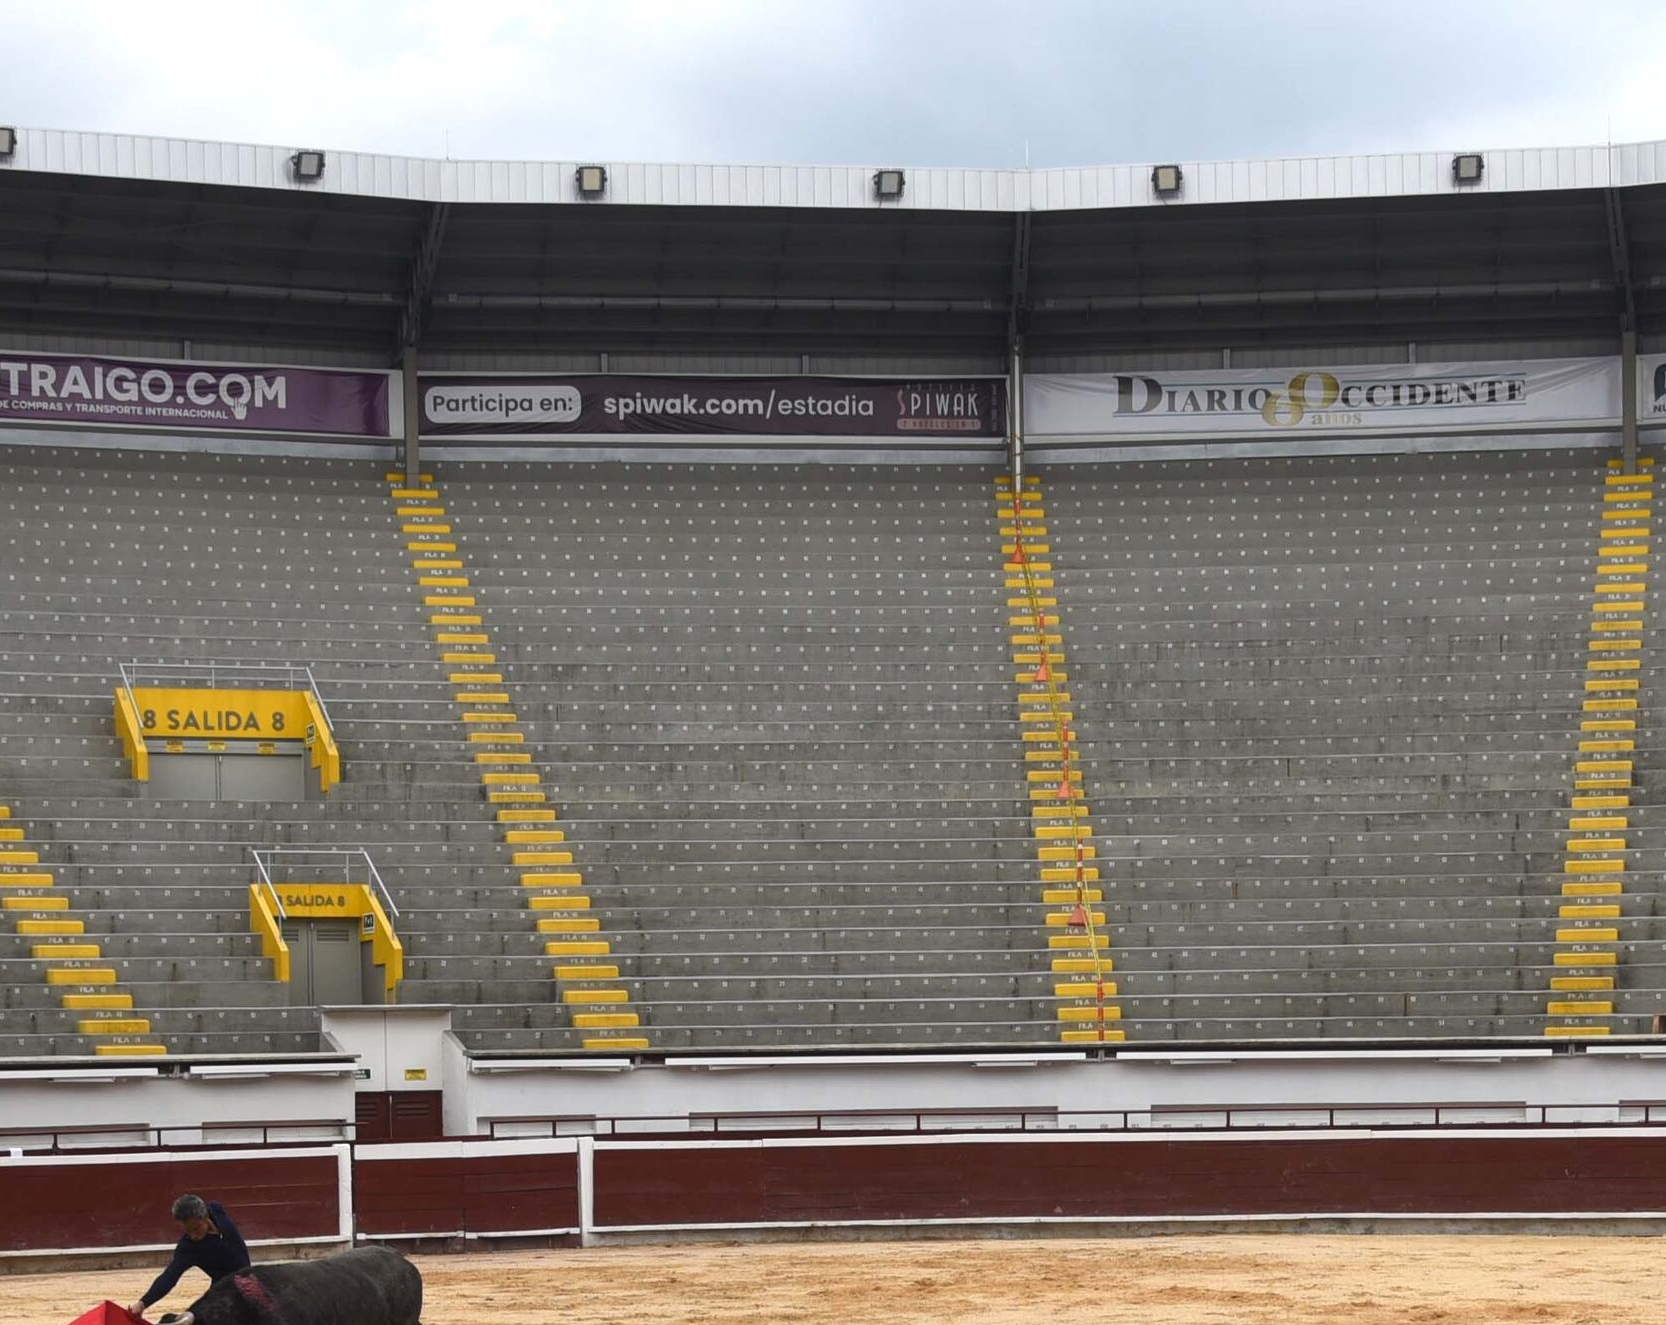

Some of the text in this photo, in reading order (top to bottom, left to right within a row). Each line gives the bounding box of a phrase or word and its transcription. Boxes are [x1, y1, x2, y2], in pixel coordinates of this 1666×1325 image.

[433, 392, 574, 418] Participa en:
[603, 388, 875, 421] spiwak.com/estadia
[896, 388, 979, 417] SPIWAK
[1112, 371, 1528, 415] DIARIO OCCIDENTE
[11, 400, 64, 412] COMPRAS
[65, 403, 73, 412] Y
[75, 402, 144, 416] TRANSPORTE
[145, 407, 229, 419] INTERNACIONAL
[143, 709, 285, 732] 8 SALIDA 8
[285, 894, 335, 907] SALIDA
[337, 895, 346, 907] 8
